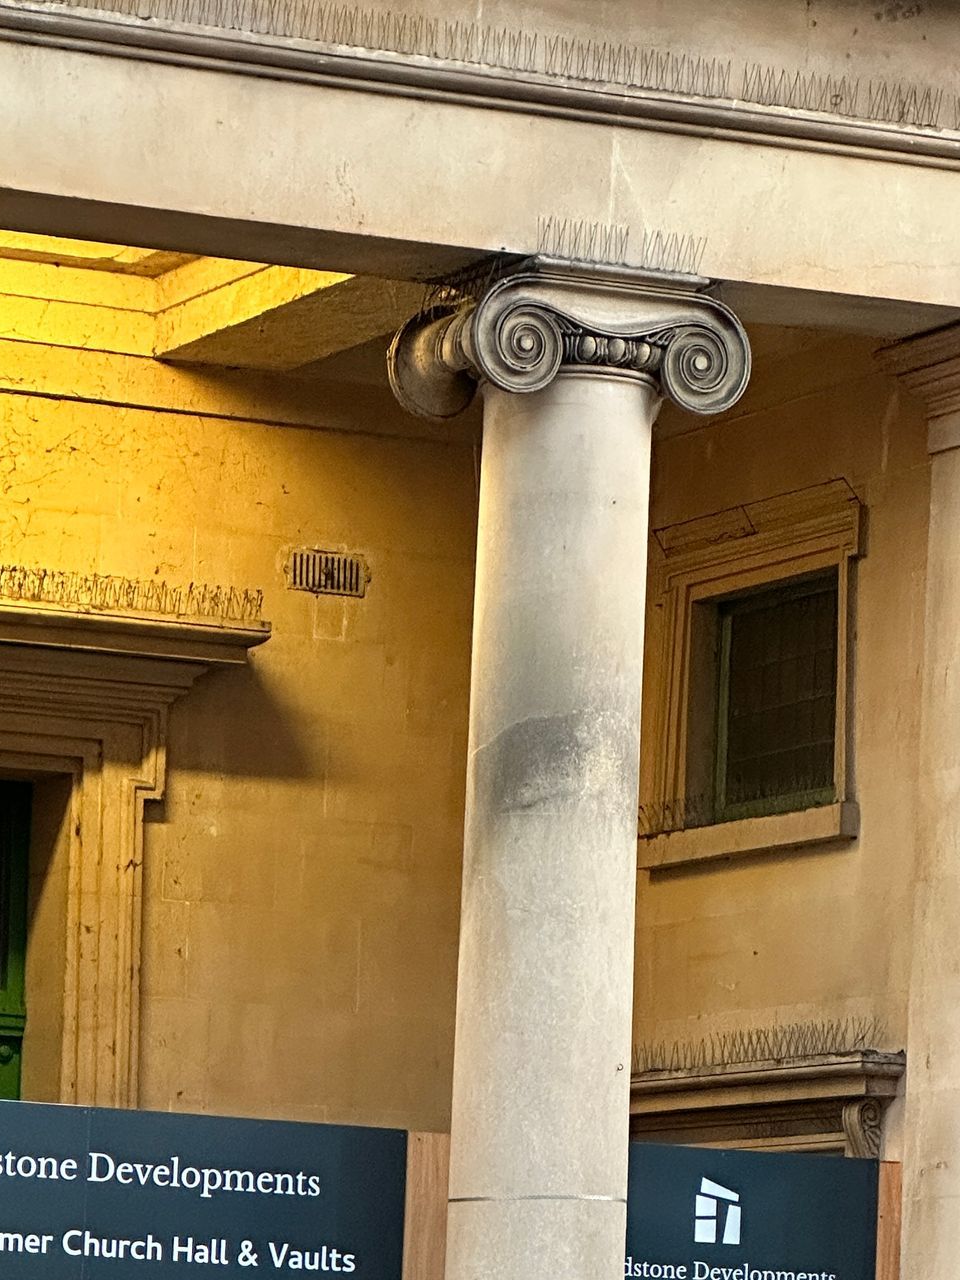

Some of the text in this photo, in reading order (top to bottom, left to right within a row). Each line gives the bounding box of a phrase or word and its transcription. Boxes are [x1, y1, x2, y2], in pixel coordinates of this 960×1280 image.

[86, 1152, 321, 1198] Developments
[62, 1229, 163, 1261] Church
[172, 1232, 229, 1265] Hall
[237, 1239, 259, 1267] &
[268, 1242, 356, 1273] Vaults
[624, 1256, 688, 1280] dstone
